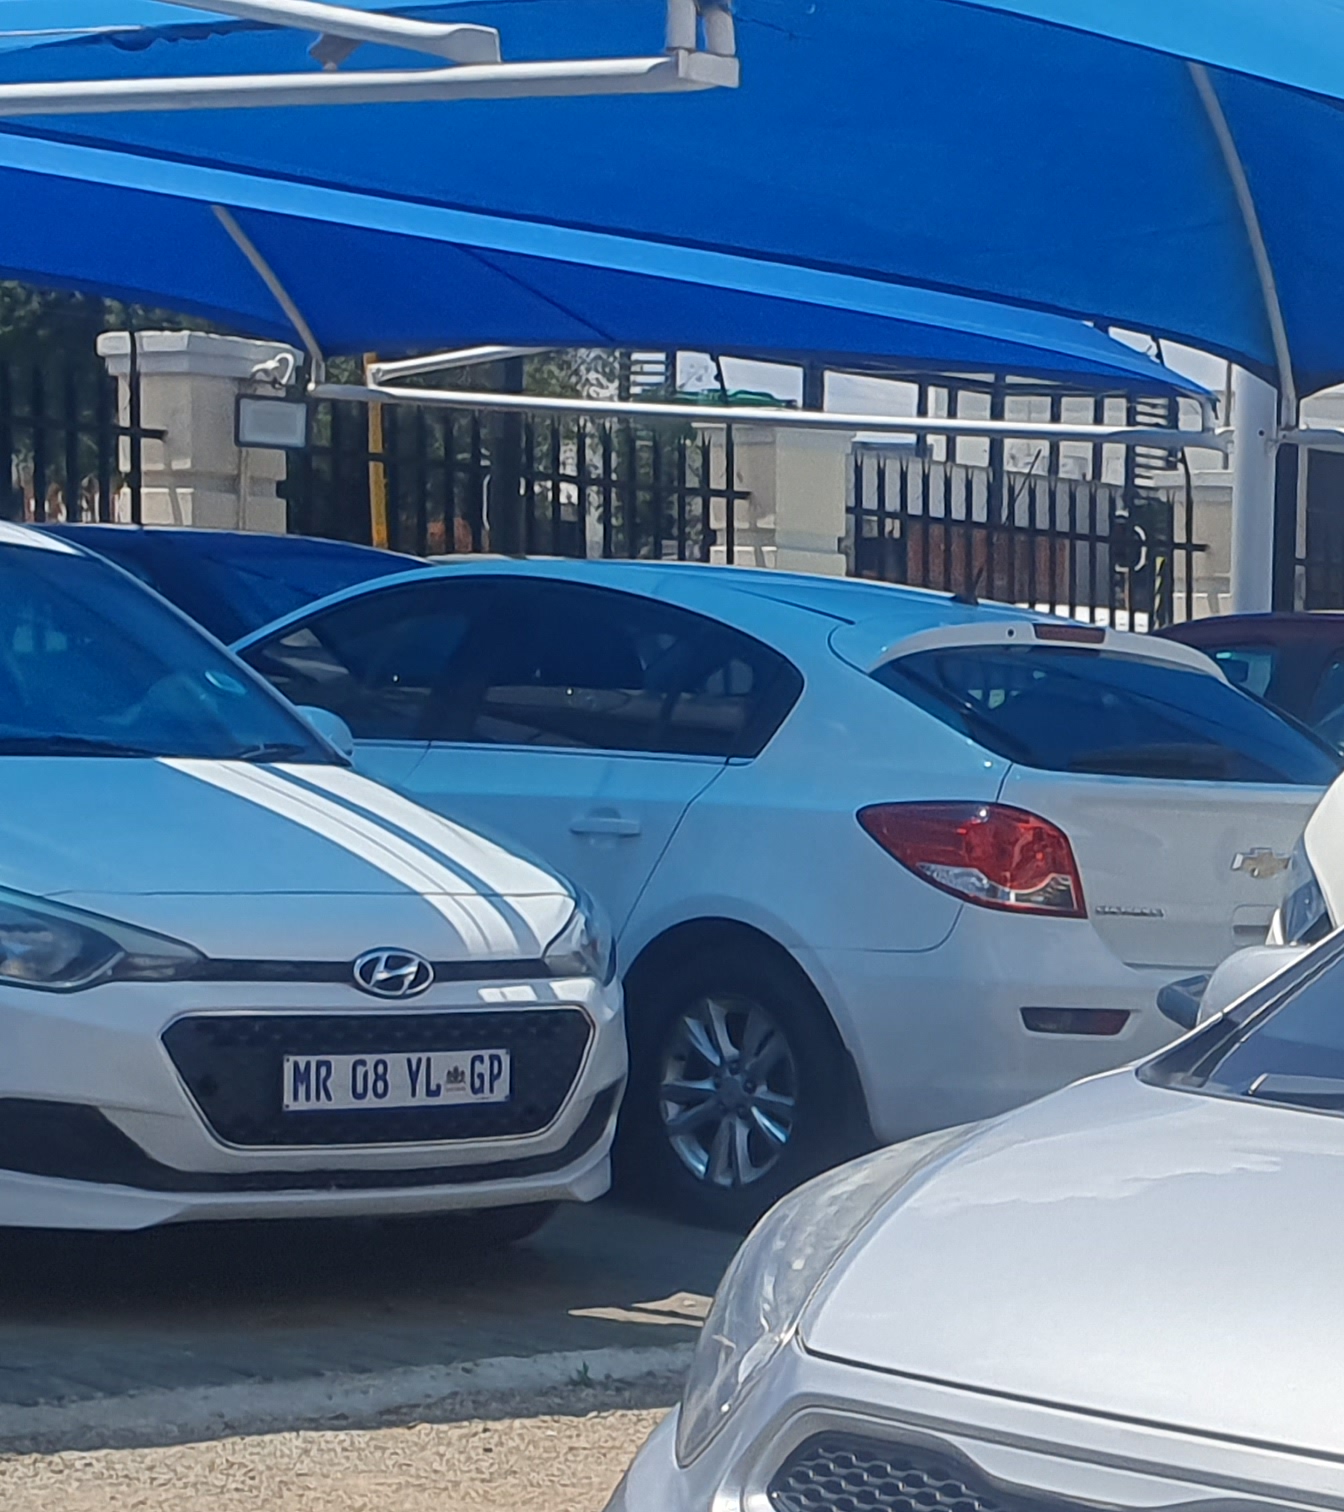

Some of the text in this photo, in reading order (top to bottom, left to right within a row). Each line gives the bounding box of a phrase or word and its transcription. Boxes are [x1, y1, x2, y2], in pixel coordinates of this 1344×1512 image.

[293, 1054, 502, 1102] MR 08 YL GP
